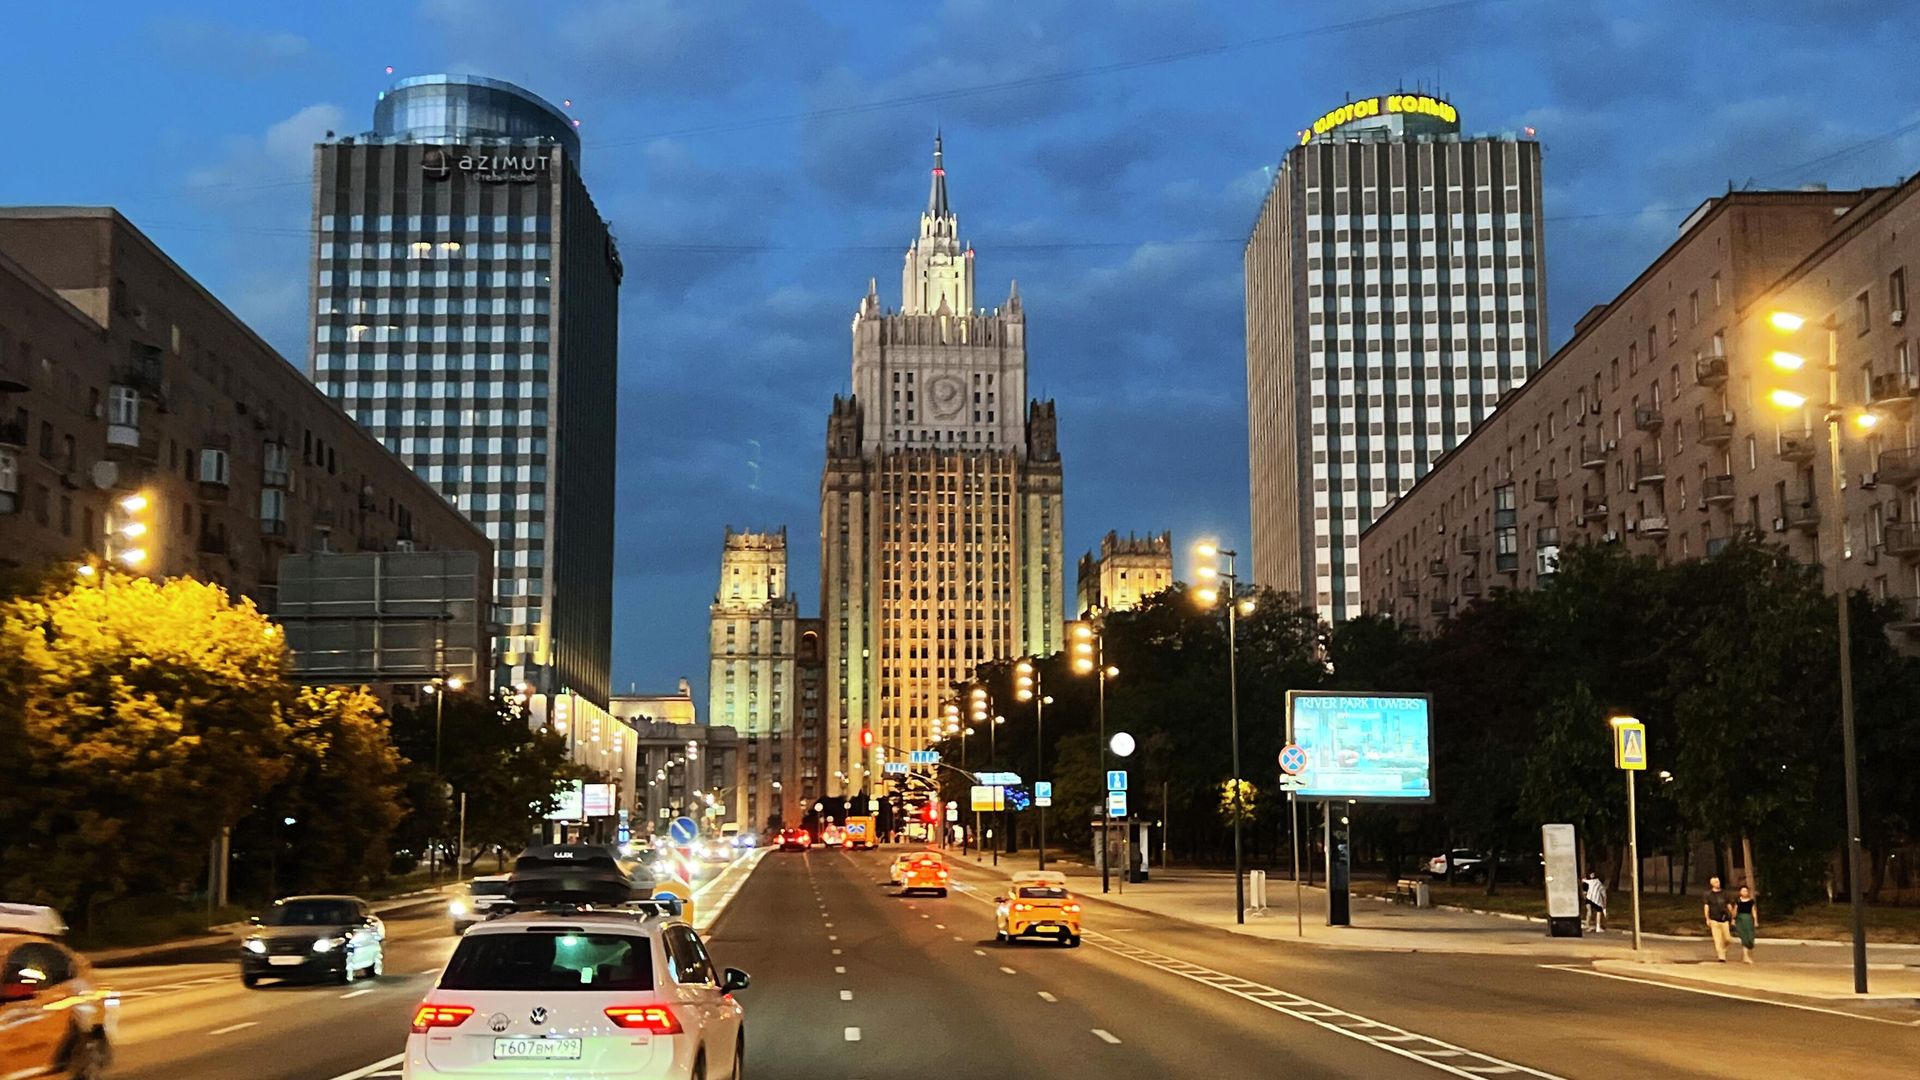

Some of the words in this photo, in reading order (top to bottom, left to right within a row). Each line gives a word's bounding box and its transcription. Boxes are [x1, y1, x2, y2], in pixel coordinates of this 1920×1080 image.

[1302, 698, 1337, 709] RIVER
[1339, 698, 1369, 709] PARK
[1373, 698, 1420, 710] TOWERS
[556, 1040, 577, 1051] 799
